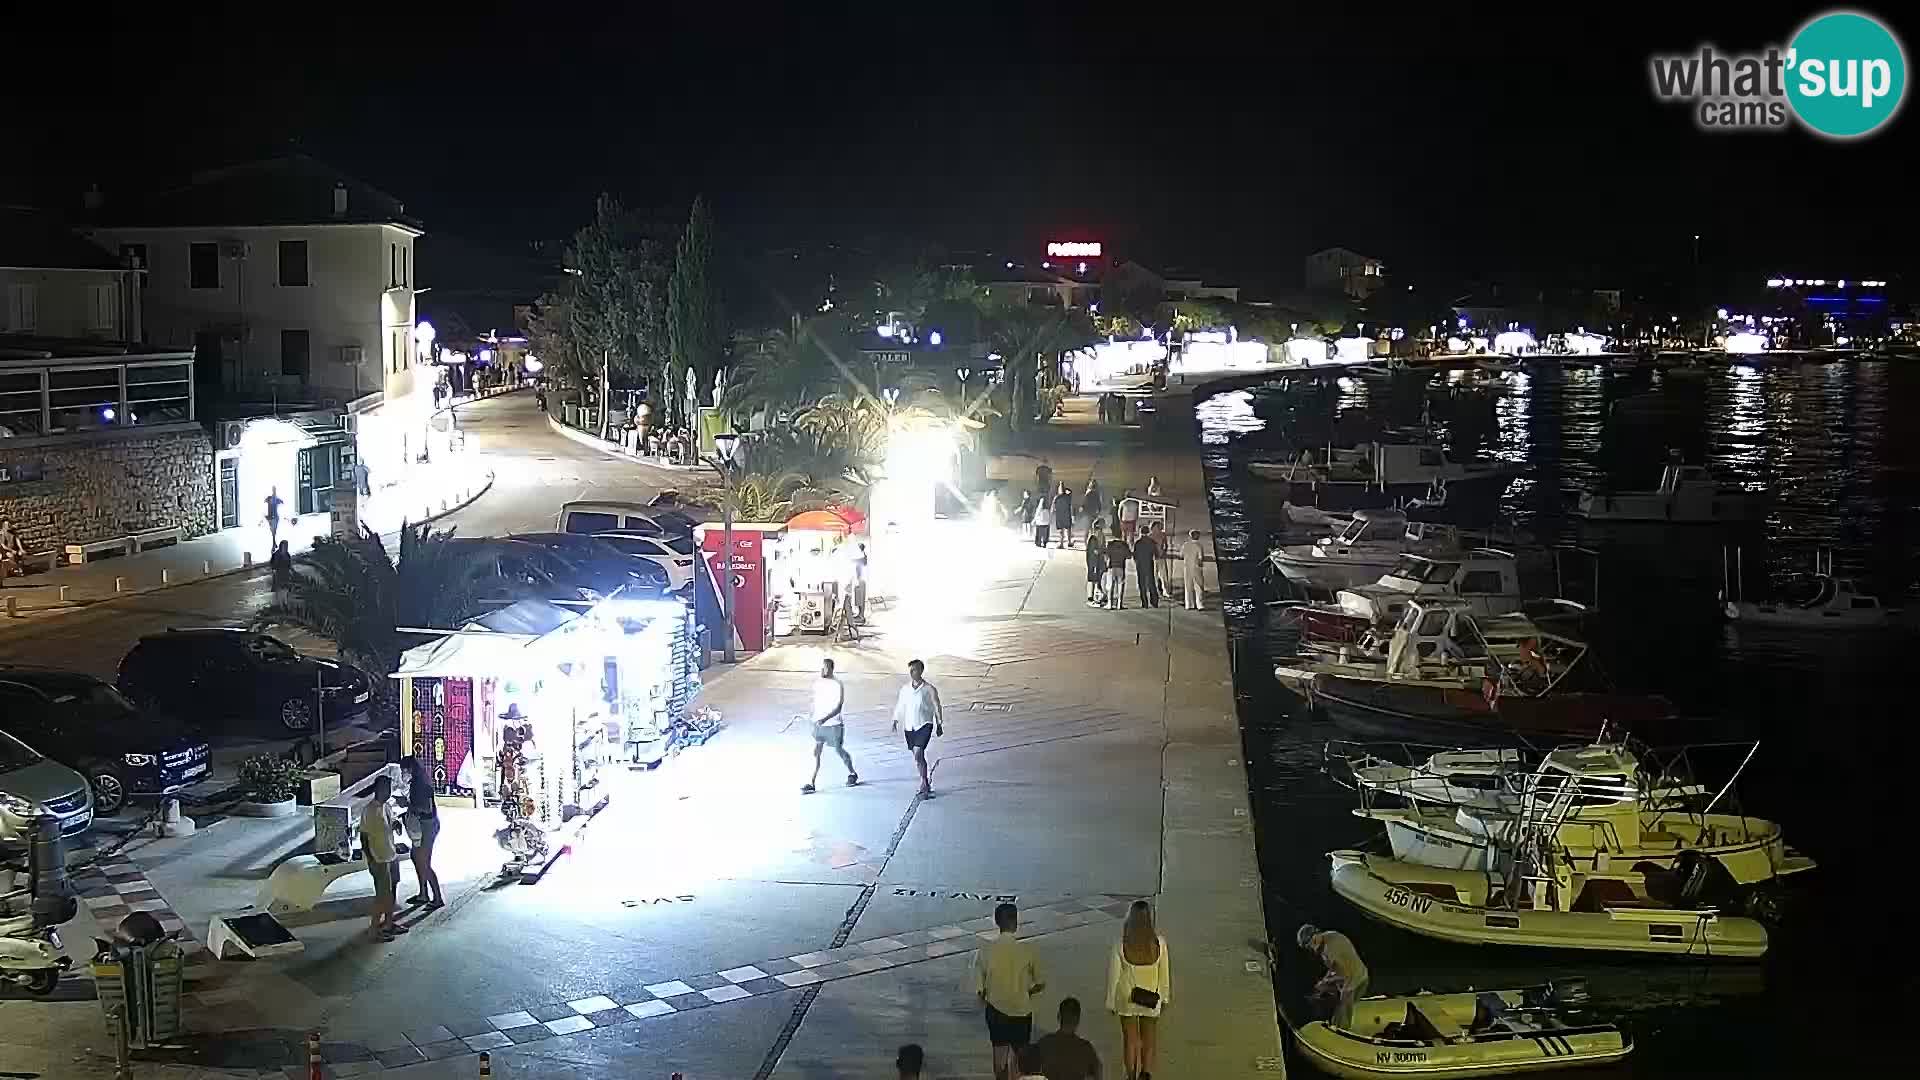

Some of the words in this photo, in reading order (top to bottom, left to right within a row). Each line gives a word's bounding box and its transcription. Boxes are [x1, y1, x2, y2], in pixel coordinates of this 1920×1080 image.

[1384, 887, 1409, 907] 456
[1410, 896, 1432, 914] NV
[1376, 1051, 1391, 1064] NV
